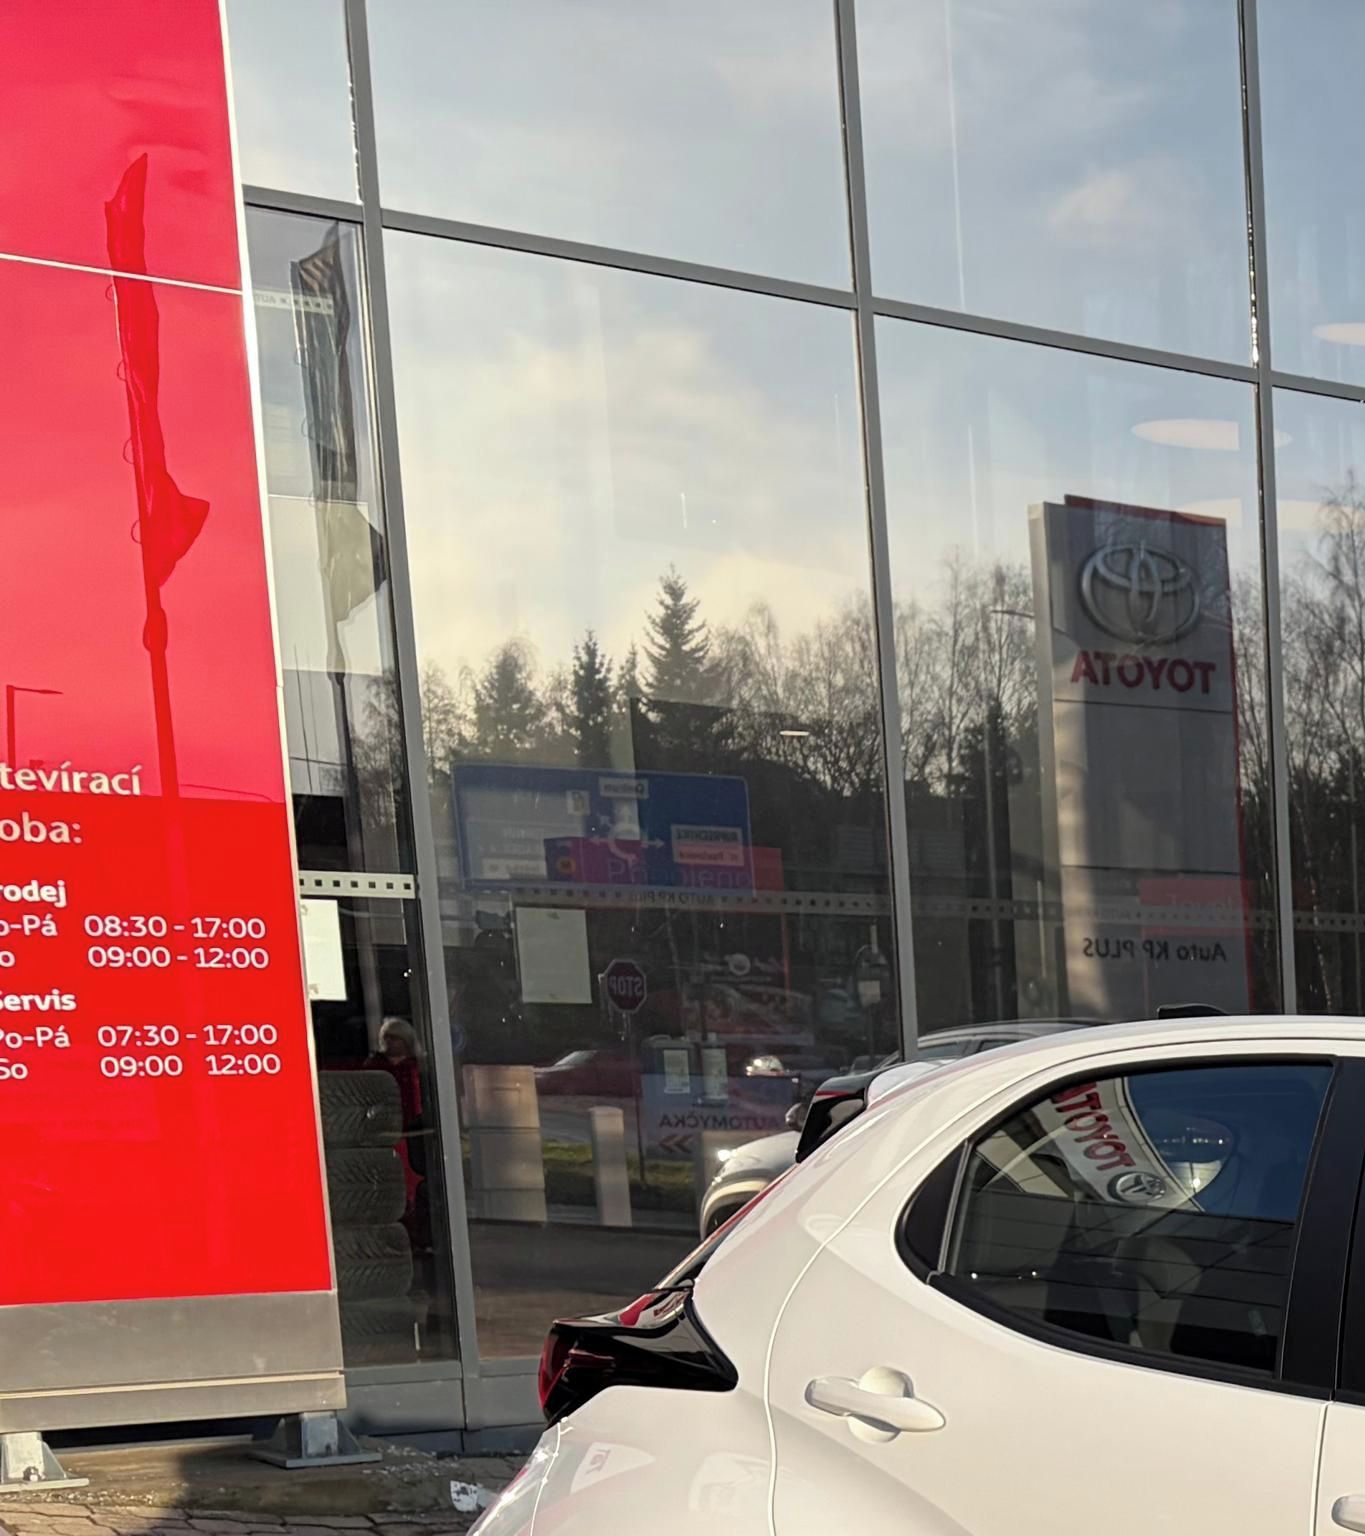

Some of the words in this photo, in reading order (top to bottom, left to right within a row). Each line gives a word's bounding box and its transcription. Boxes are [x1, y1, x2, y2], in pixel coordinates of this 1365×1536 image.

[84, 915, 168, 937] 08:30
[190, 917, 266, 939] 17:00
[88, 946, 171, 968] 09:00
[193, 947, 269, 969] 12:00
[97, 1025, 180, 1047] 07:30
[202, 1024, 278, 1046] 17:00
[100, 1055, 183, 1077] 09:00
[205, 1054, 281, 1076] 12:00
